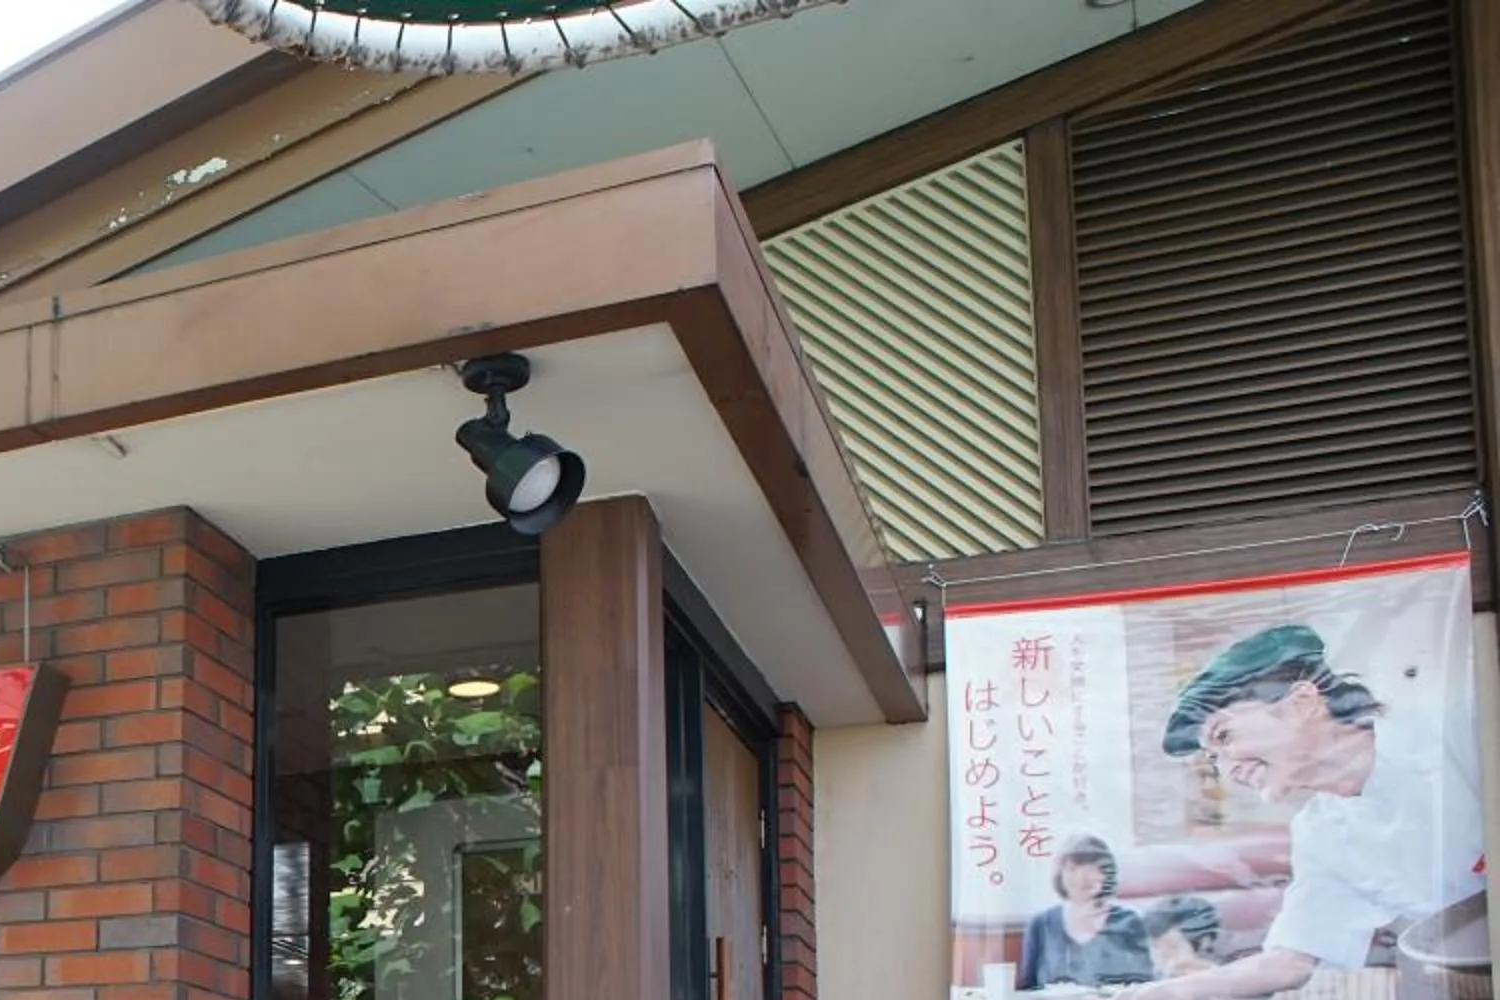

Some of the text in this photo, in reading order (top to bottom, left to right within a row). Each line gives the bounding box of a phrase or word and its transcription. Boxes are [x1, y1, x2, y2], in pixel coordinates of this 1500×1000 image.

[964, 678, 1004, 887] はじめよう。
[1011, 634, 1054, 859] 新しいことを
